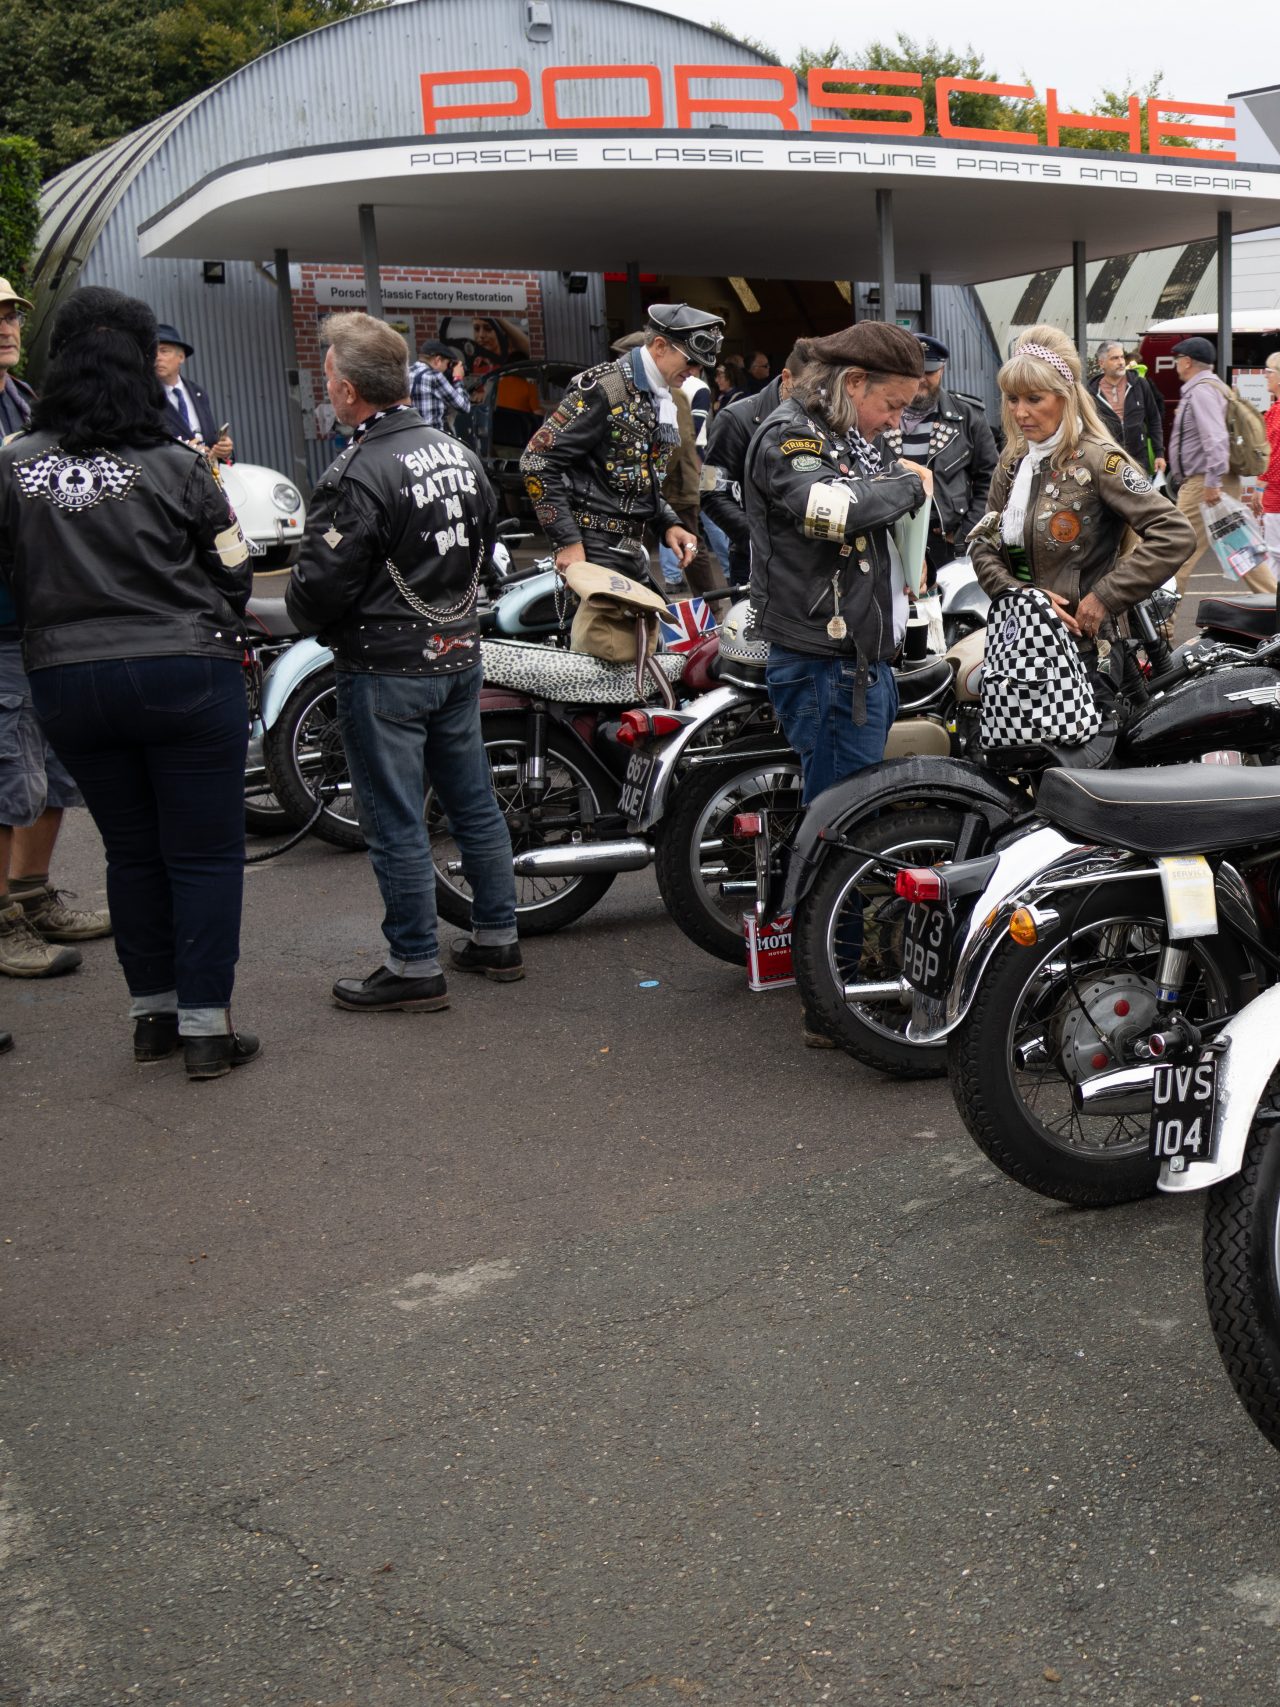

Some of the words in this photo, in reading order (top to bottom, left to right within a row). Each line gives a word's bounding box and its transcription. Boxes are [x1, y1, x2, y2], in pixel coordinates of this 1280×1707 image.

[420, 64, 1236, 162] PORSCHE
[411, 148, 578, 167] PORSCHE
[602, 147, 764, 164] CLASSIC
[788, 149, 936, 169] GENUINE
[957, 157, 1061, 178] PARTS
[1080, 167, 1138, 184] AND
[1156, 173, 1251, 192] REPAIR
[330, 287, 366, 299] Porsch
[415, 289, 454, 303] Factory
[456, 290, 513, 303] Restoration
[404, 442, 469, 477] SHAKE
[786, 440, 817, 450] TRIBSA
[53, 460, 74, 478] ACE
[75, 459, 100, 479] CAFE
[53, 488, 98, 505] LONDON
[412, 468, 477, 508] RATTLE
[626, 753, 651, 785] 667
[617, 783, 643, 816] XUE
[907, 902, 944, 947] 473
[903, 936, 939, 986] PBP
[1154, 1065, 1212, 1104] UVS
[1154, 1117, 1202, 1156] 104
